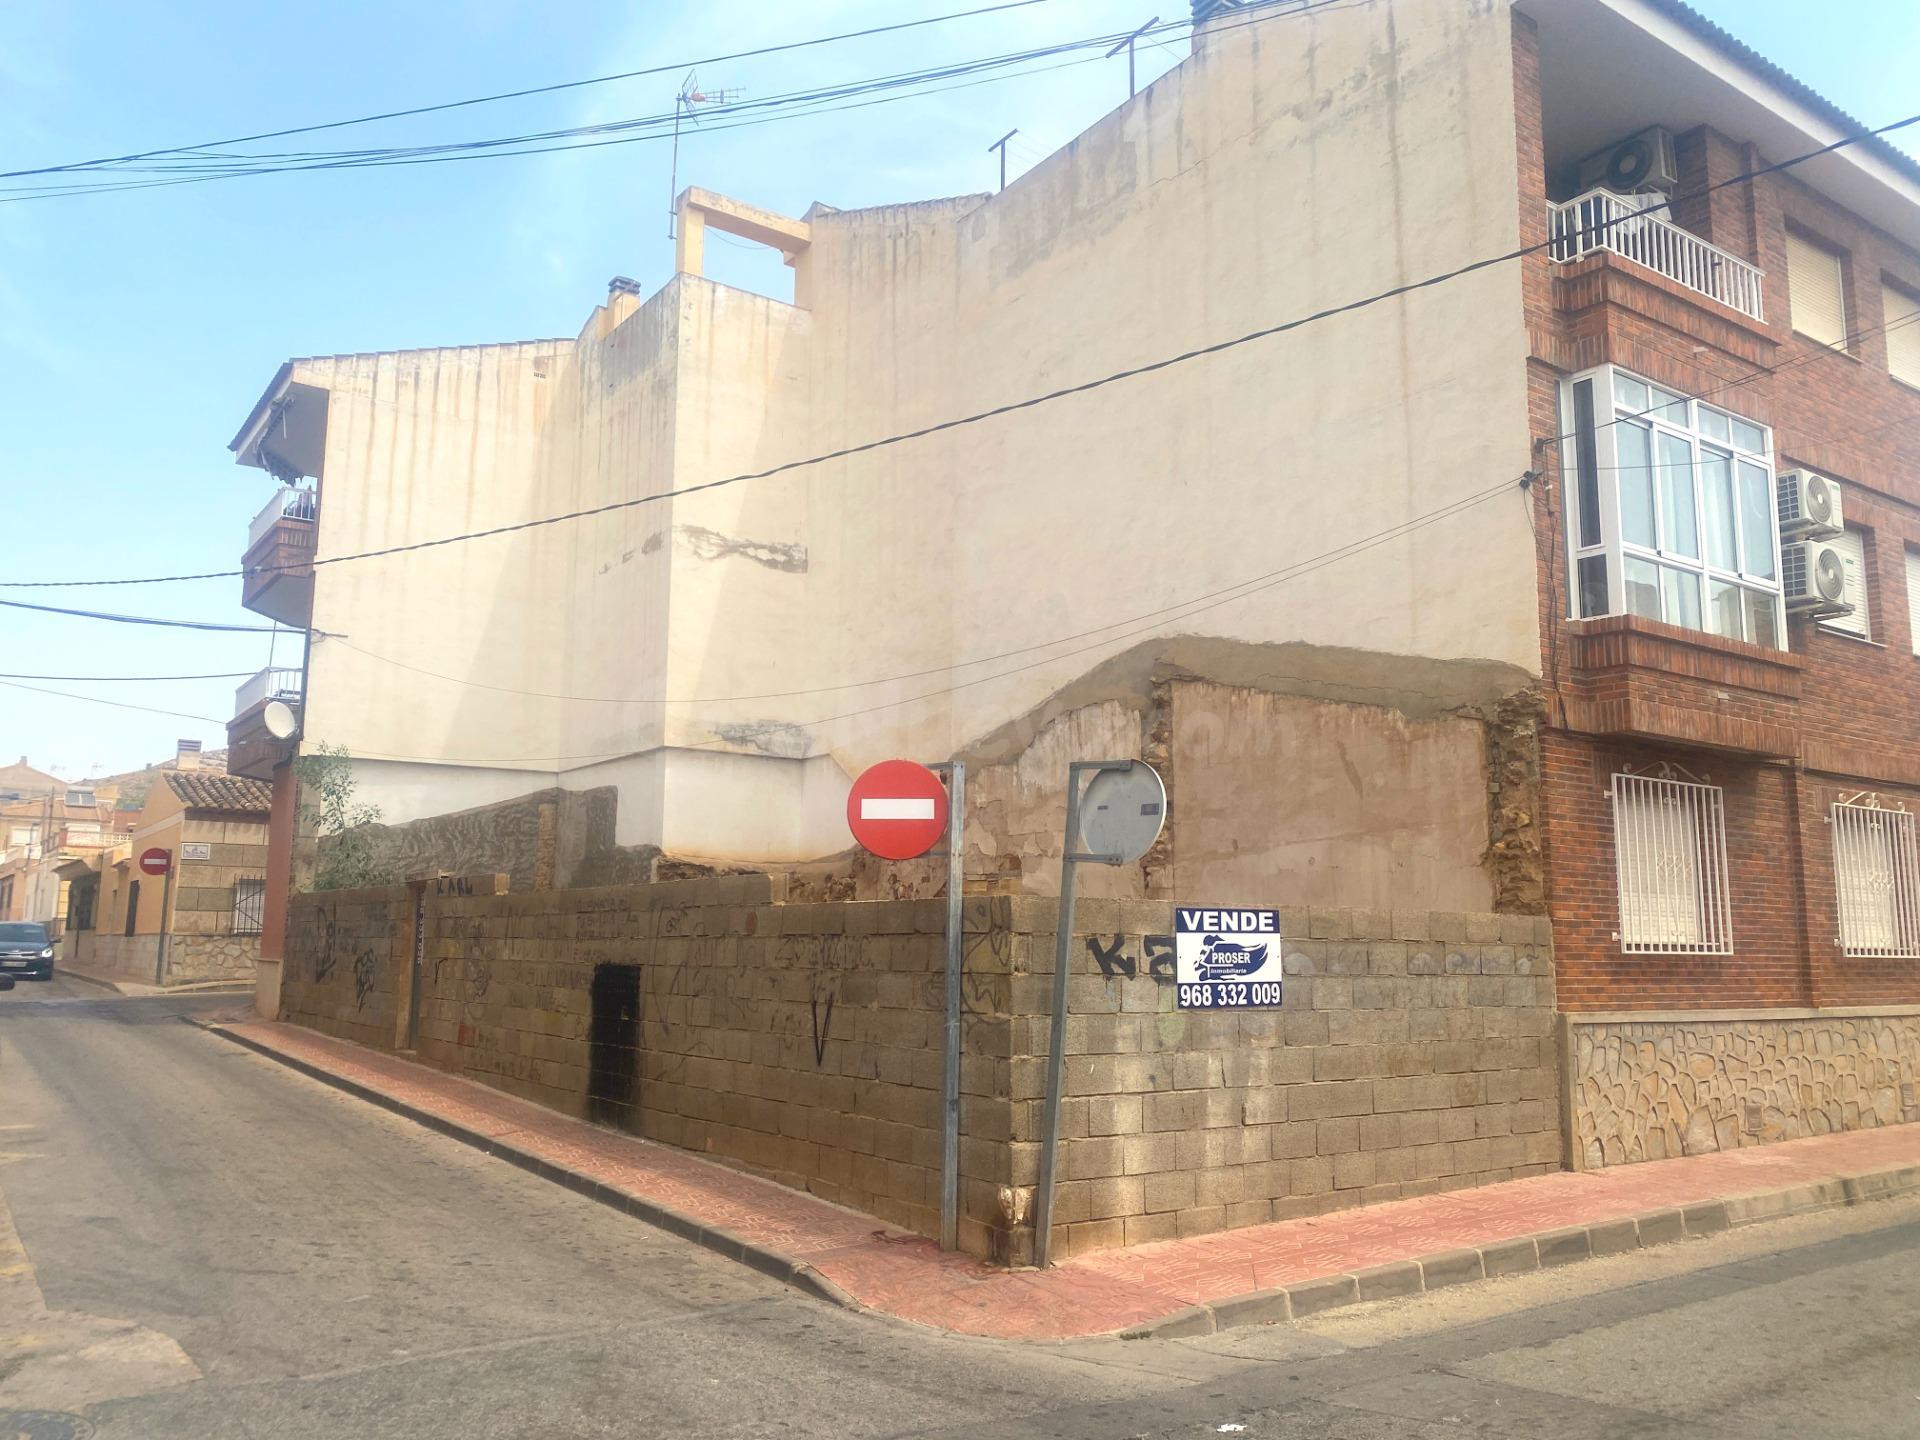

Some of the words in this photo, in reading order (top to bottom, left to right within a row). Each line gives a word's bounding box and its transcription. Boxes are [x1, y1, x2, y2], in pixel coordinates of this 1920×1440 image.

[1182, 911, 1274, 931] VENDE
[1212, 952, 1251, 963] PROSER
[1180, 984, 1213, 1007] 968
[1217, 984, 1248, 1005] 332
[1252, 983, 1280, 1004] 009
